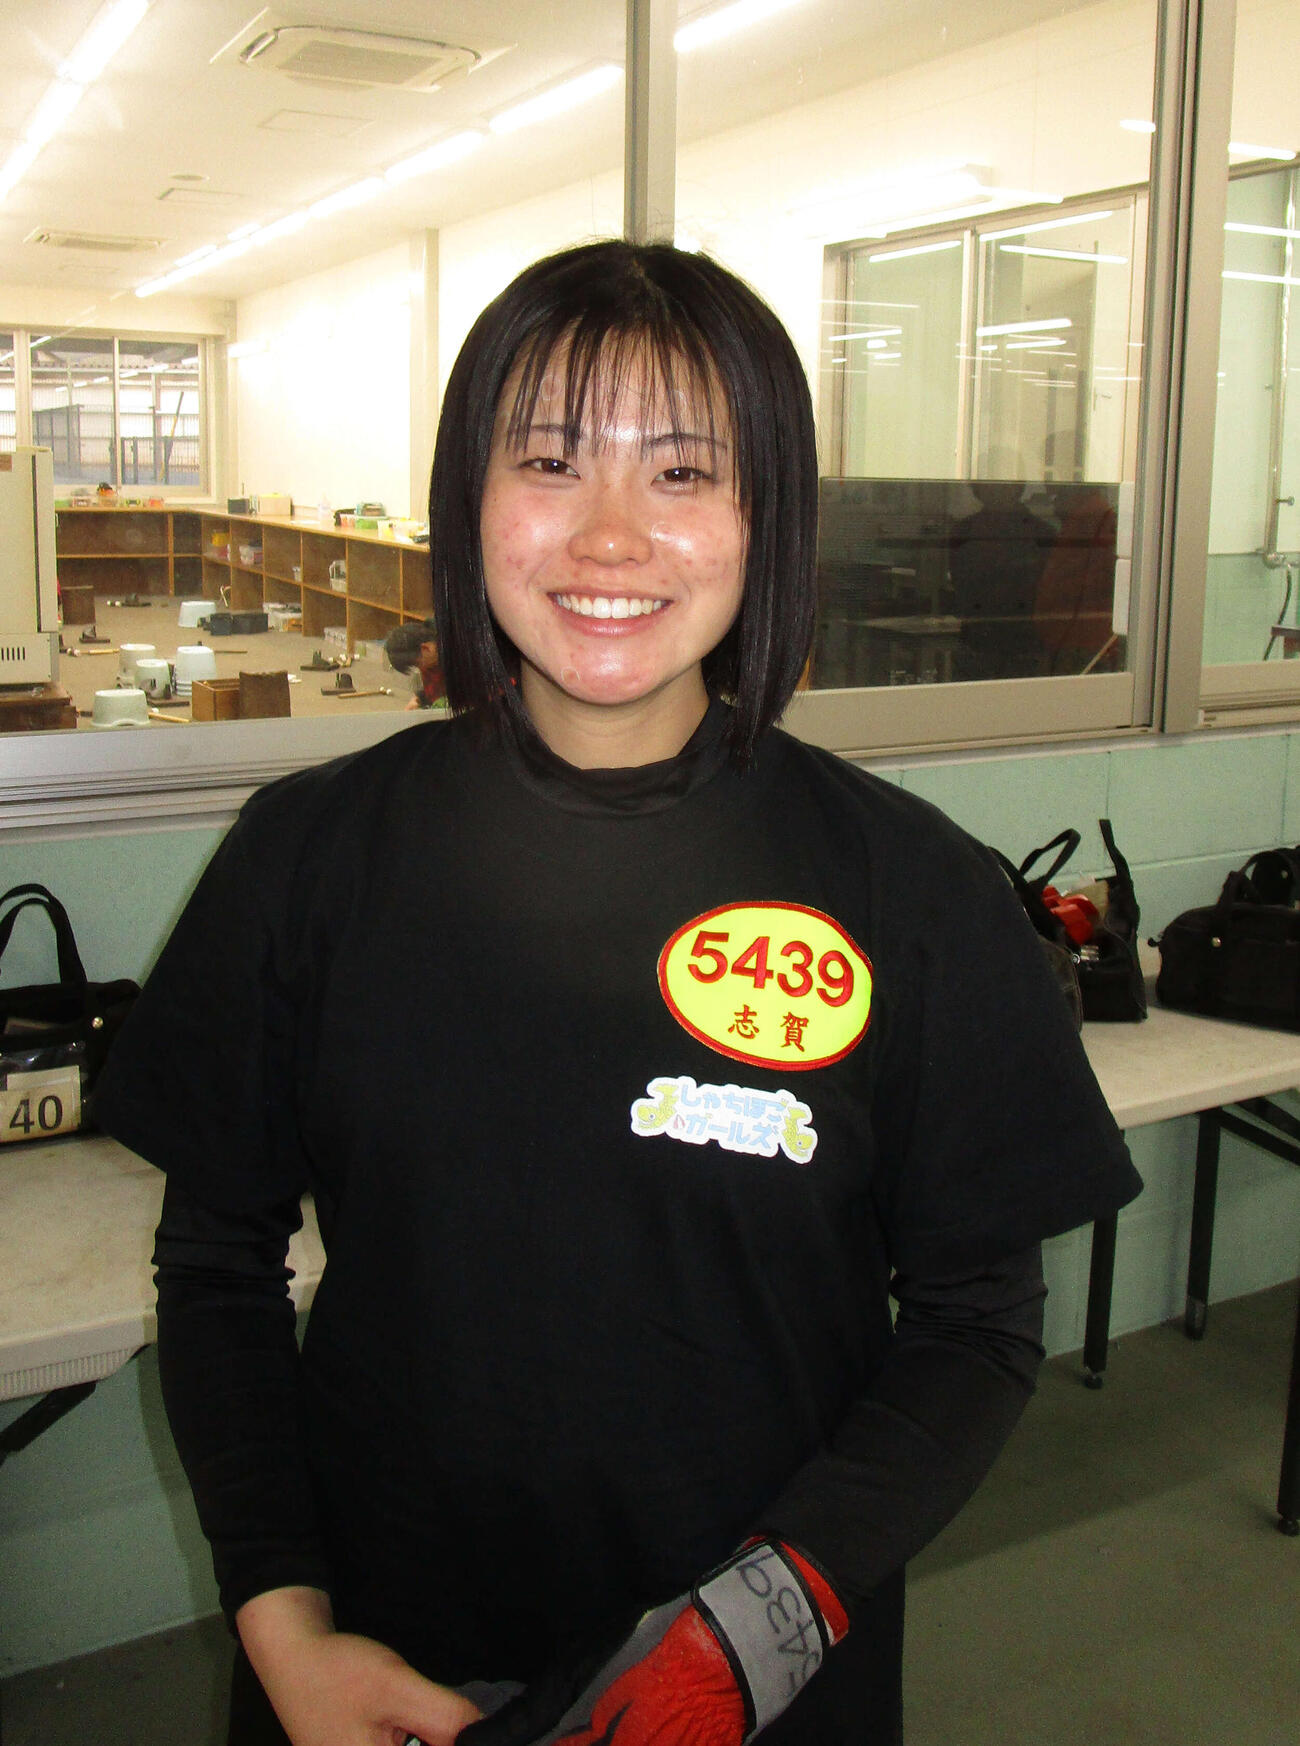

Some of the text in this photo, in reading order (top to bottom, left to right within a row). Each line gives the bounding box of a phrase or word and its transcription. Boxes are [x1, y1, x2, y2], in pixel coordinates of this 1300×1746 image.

[688, 930, 854, 1007] 5439
[9, 1095, 63, 1134] 40
[686, 1112, 779, 1149] ガールズ
